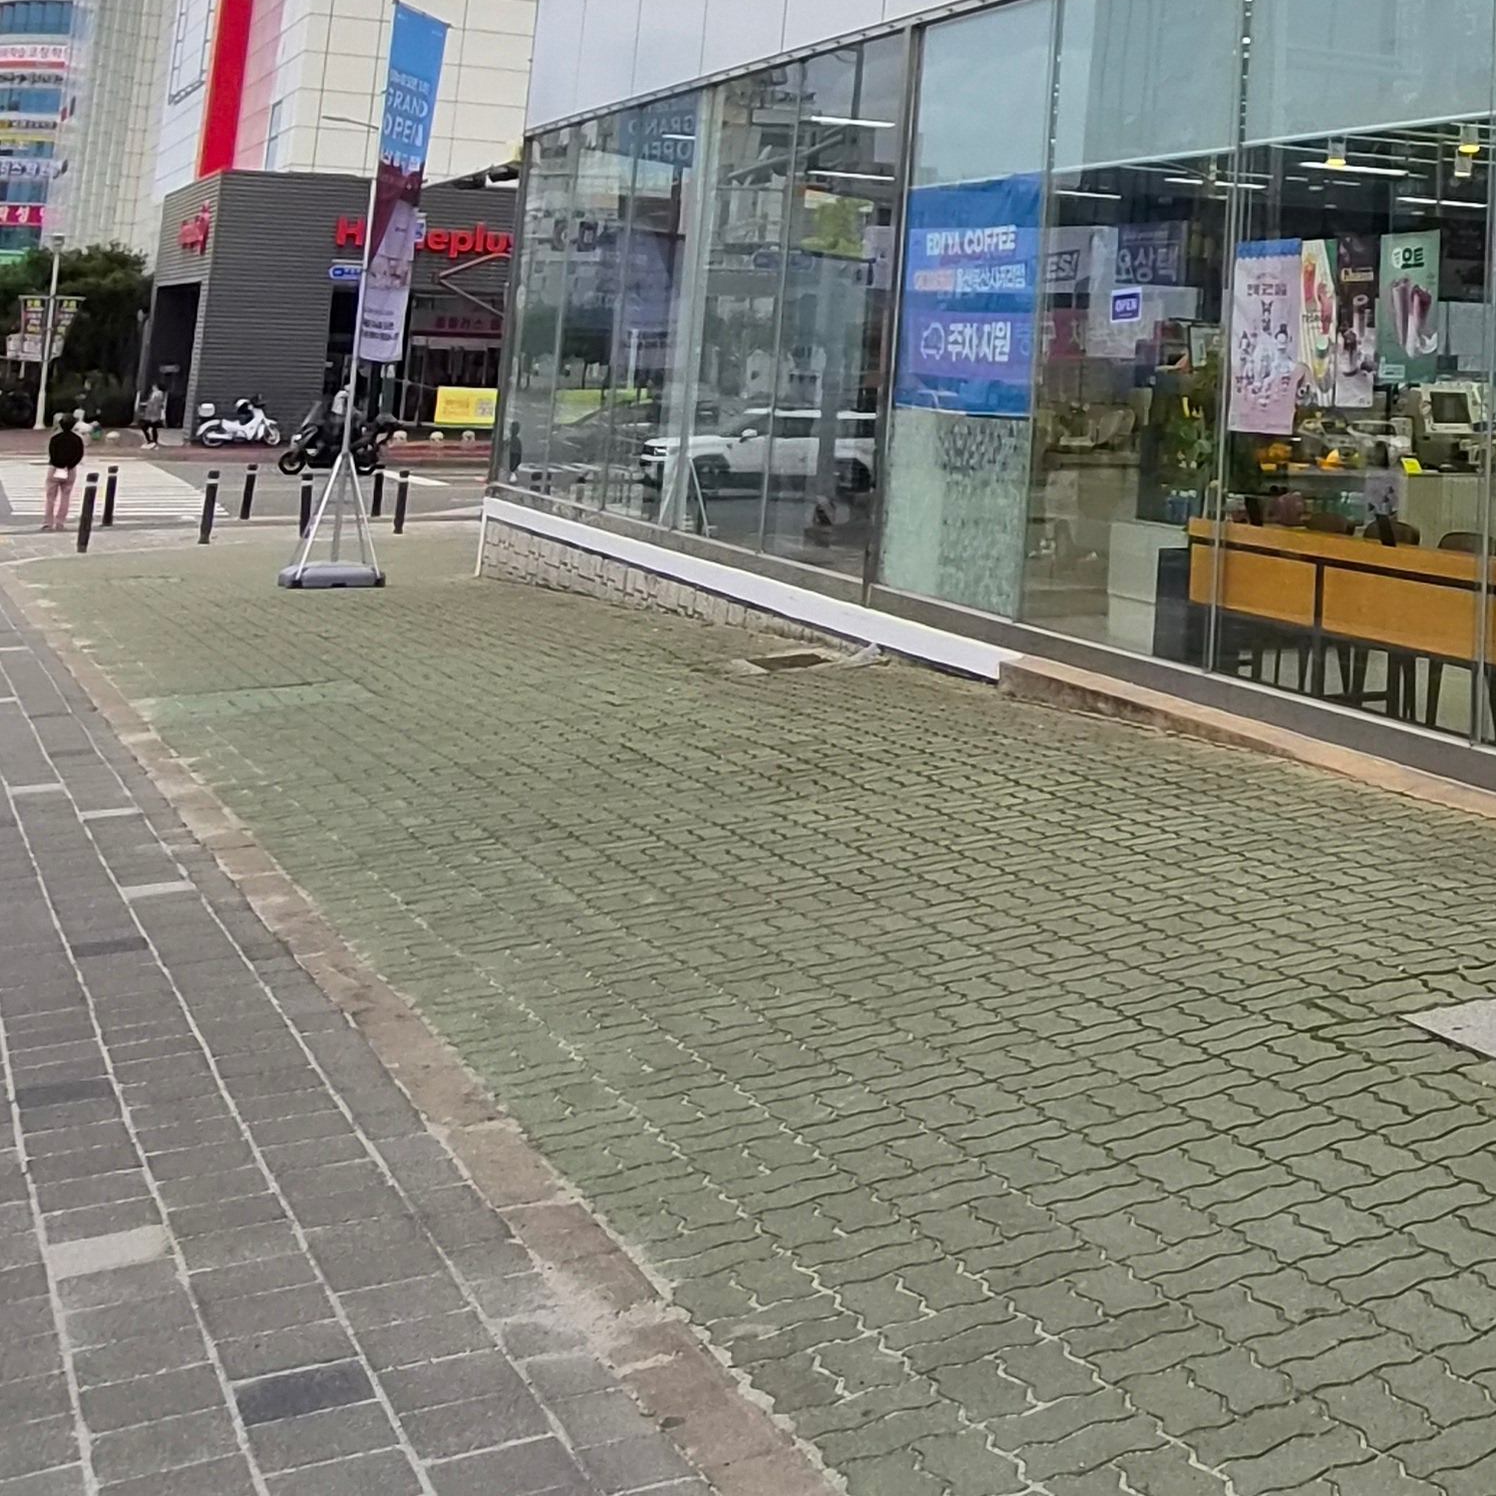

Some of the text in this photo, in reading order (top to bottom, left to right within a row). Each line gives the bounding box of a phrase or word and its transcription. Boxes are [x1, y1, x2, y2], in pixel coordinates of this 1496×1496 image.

[335, 216, 513, 258] Heplu
[926, 225, 1018, 256] EDIYA COFFEE
[1114, 298, 1138, 312] OPEN
[948, 321, 1011, 362] 주차지원
